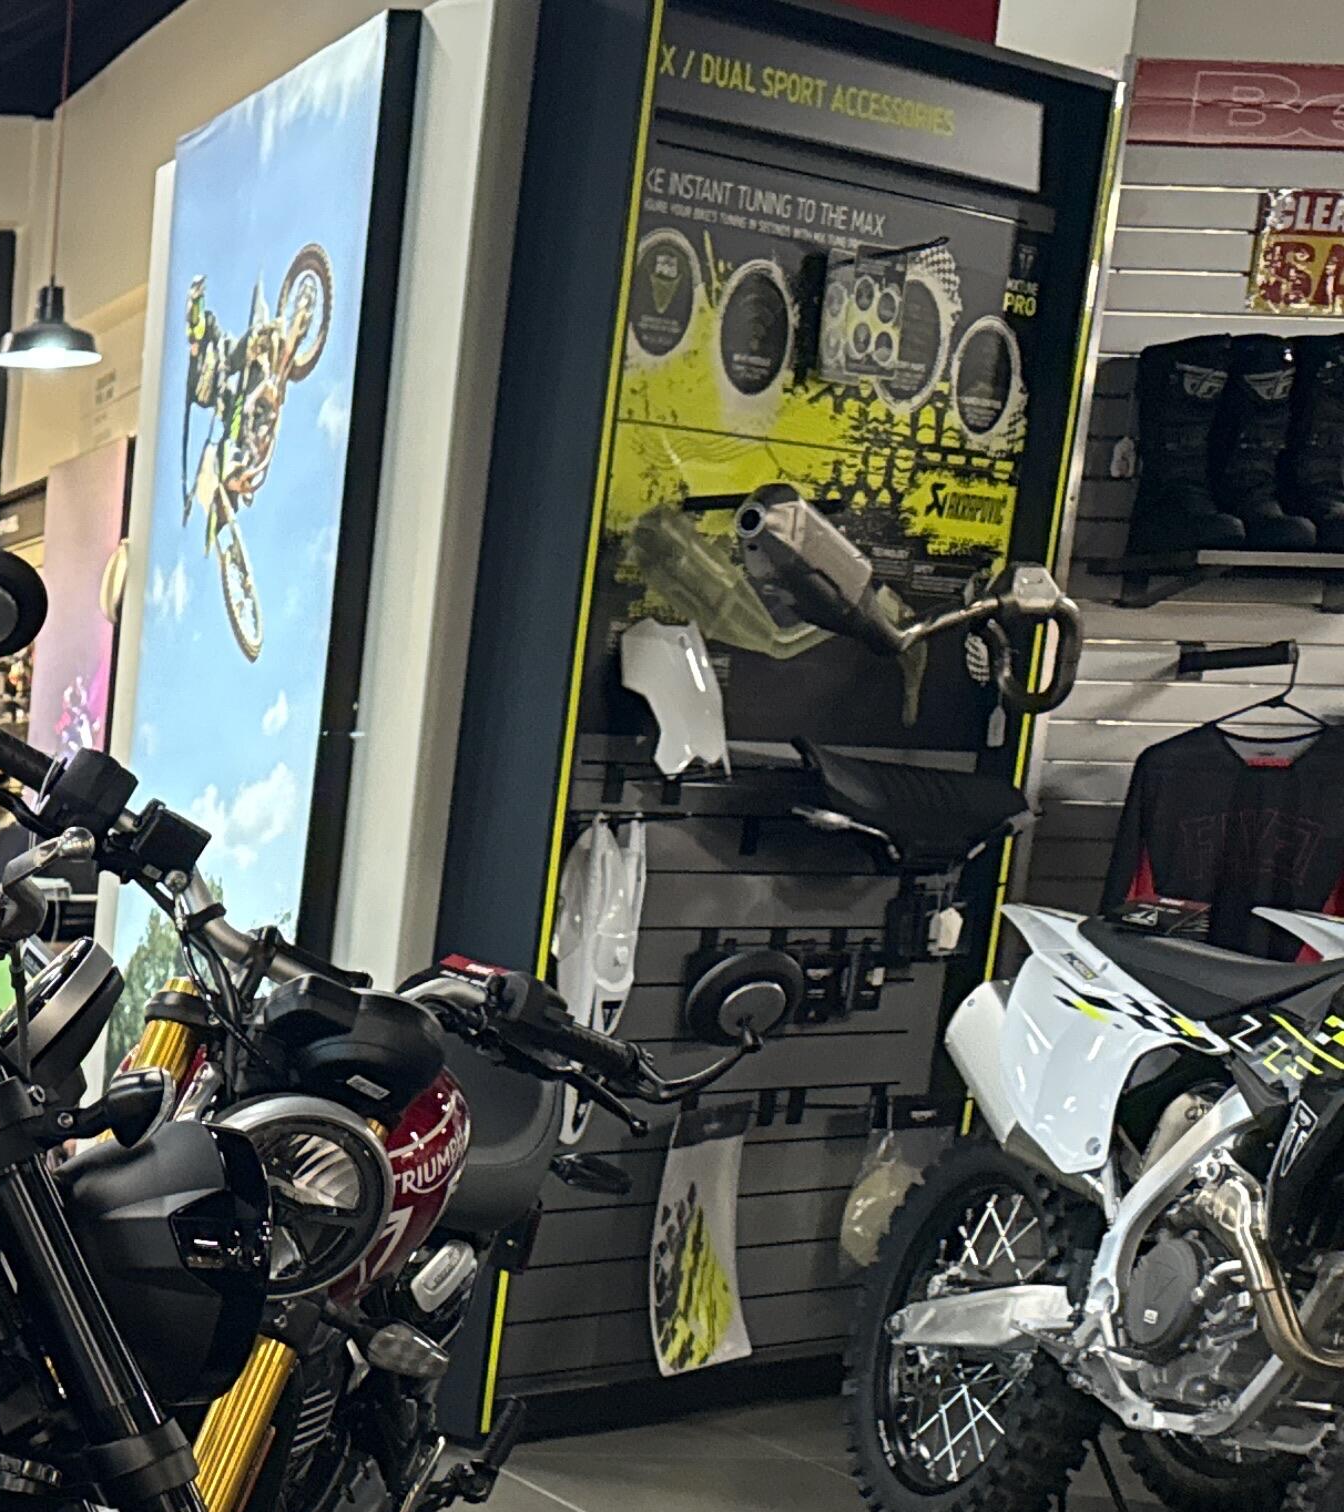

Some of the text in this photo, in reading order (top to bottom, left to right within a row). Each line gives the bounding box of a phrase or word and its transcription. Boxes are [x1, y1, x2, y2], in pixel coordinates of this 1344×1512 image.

[700, 53, 756, 94] DUAL
[760, 66, 828, 111] SPORT
[830, 84, 957, 137] ACCESSORIES
[668, 172, 734, 205] INSTANT
[736, 185, 793, 219] TUNING
[796, 197, 817, 224] TO
[819, 203, 850, 230] THE
[850, 210, 887, 238] MAX
[1002, 291, 1037, 317] PRO
